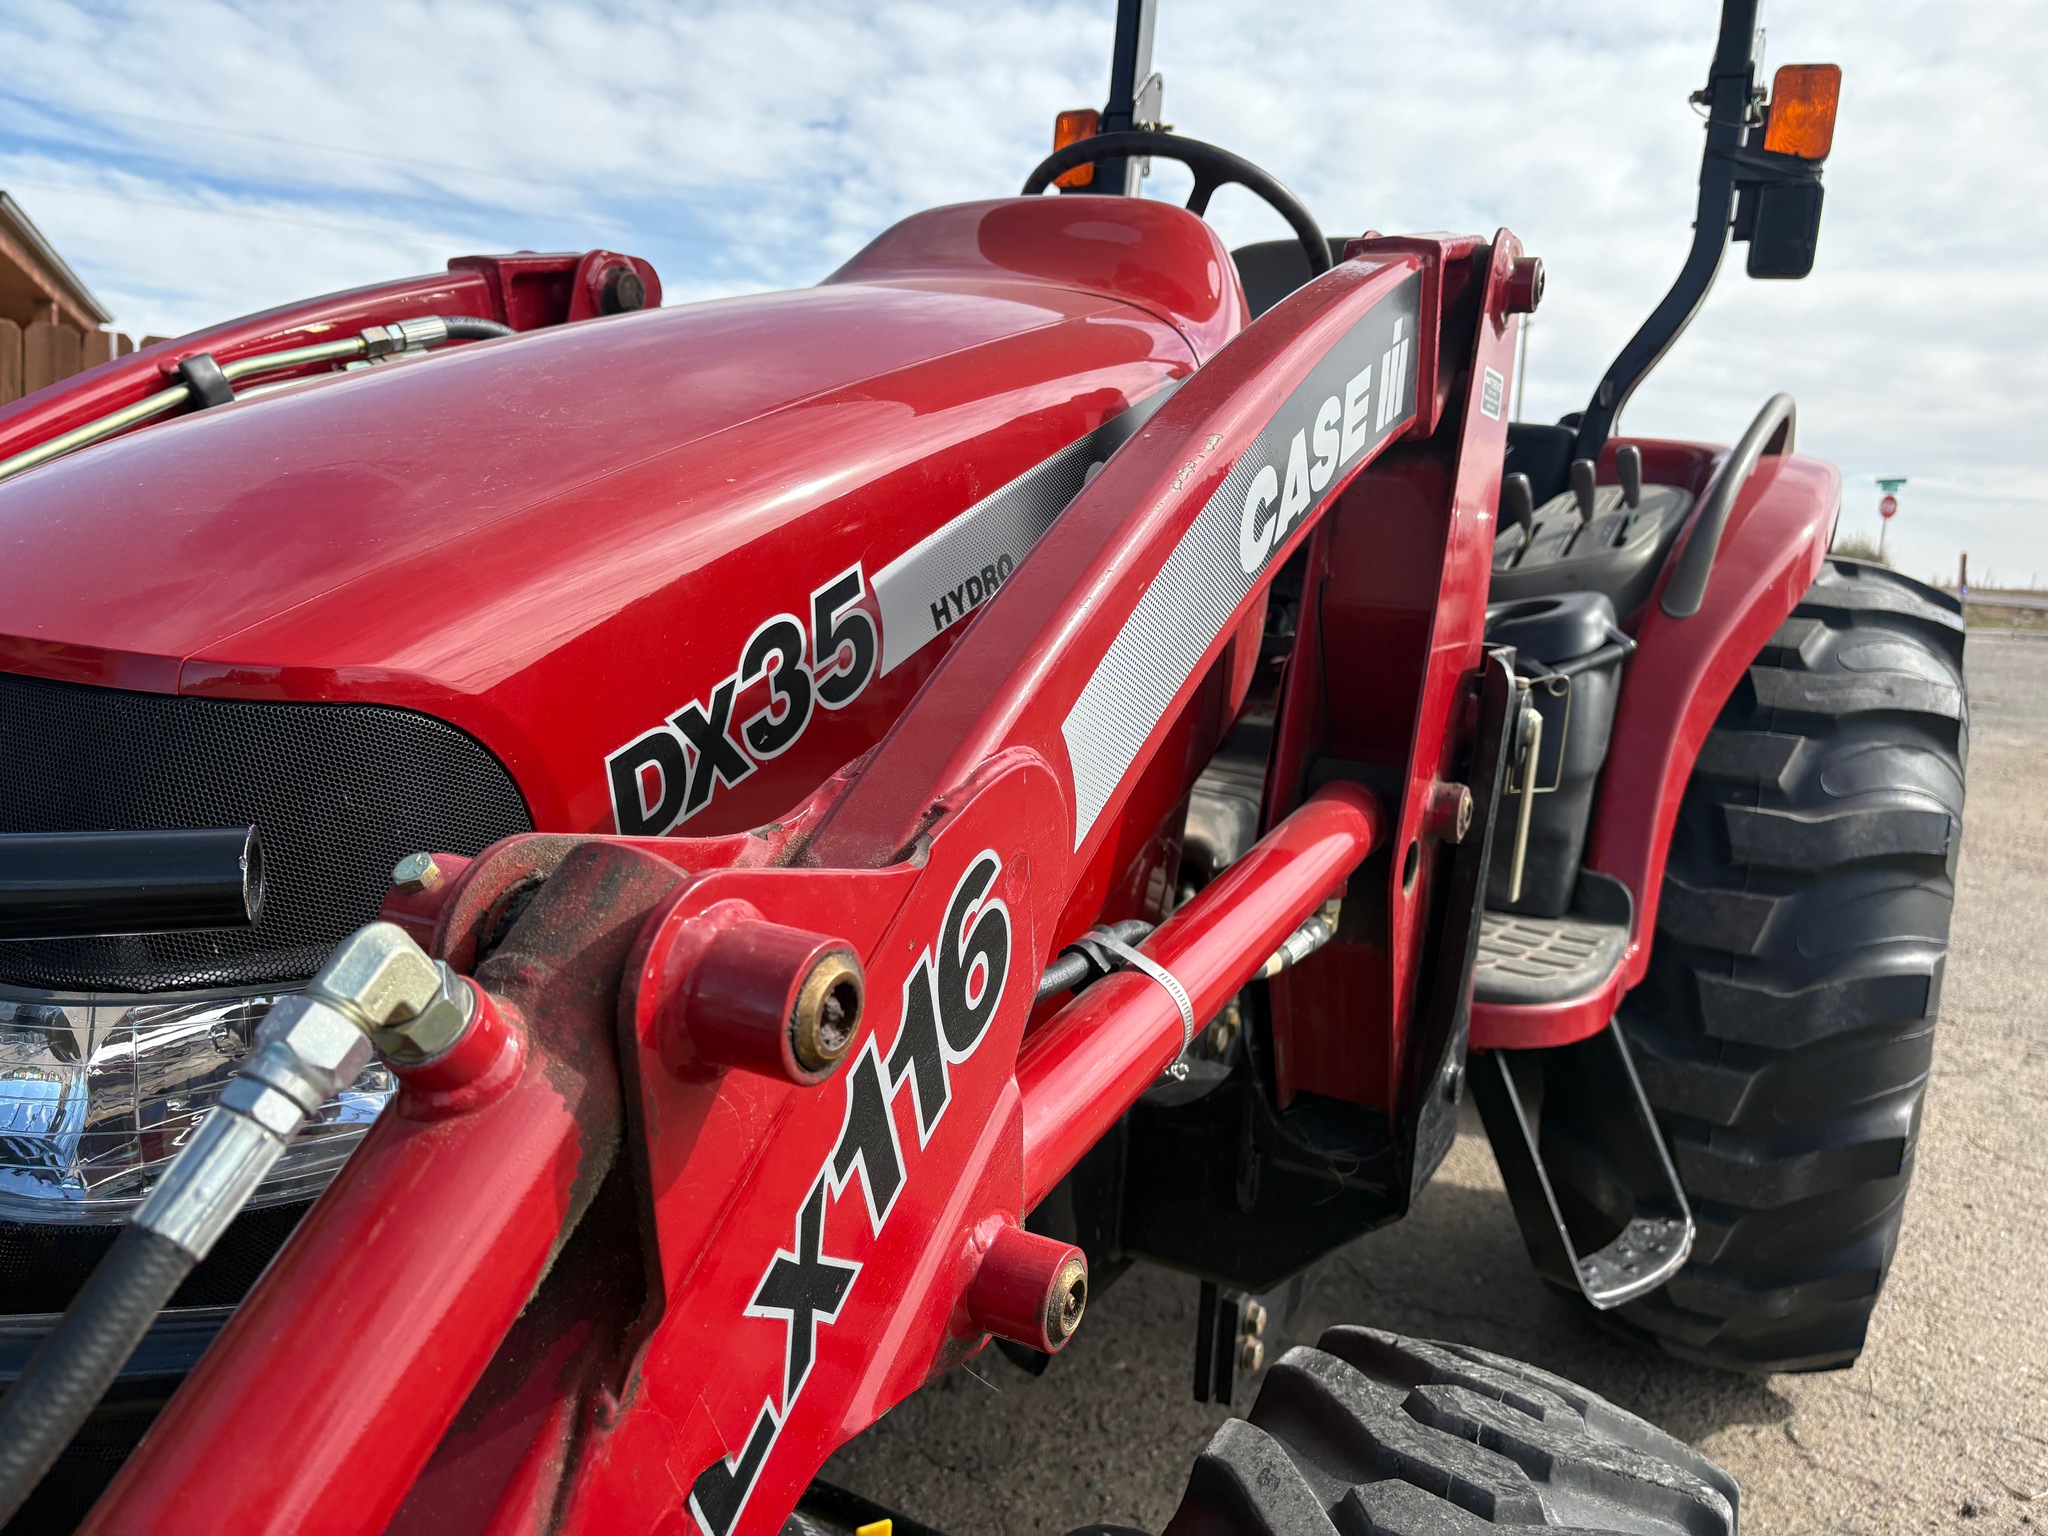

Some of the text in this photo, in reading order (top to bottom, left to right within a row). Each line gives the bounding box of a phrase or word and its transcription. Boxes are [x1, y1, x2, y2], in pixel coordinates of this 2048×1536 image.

[1239, 364, 1371, 573] CASE
[930, 553, 1014, 632] HYDRO
[604, 561, 879, 836] DX35
